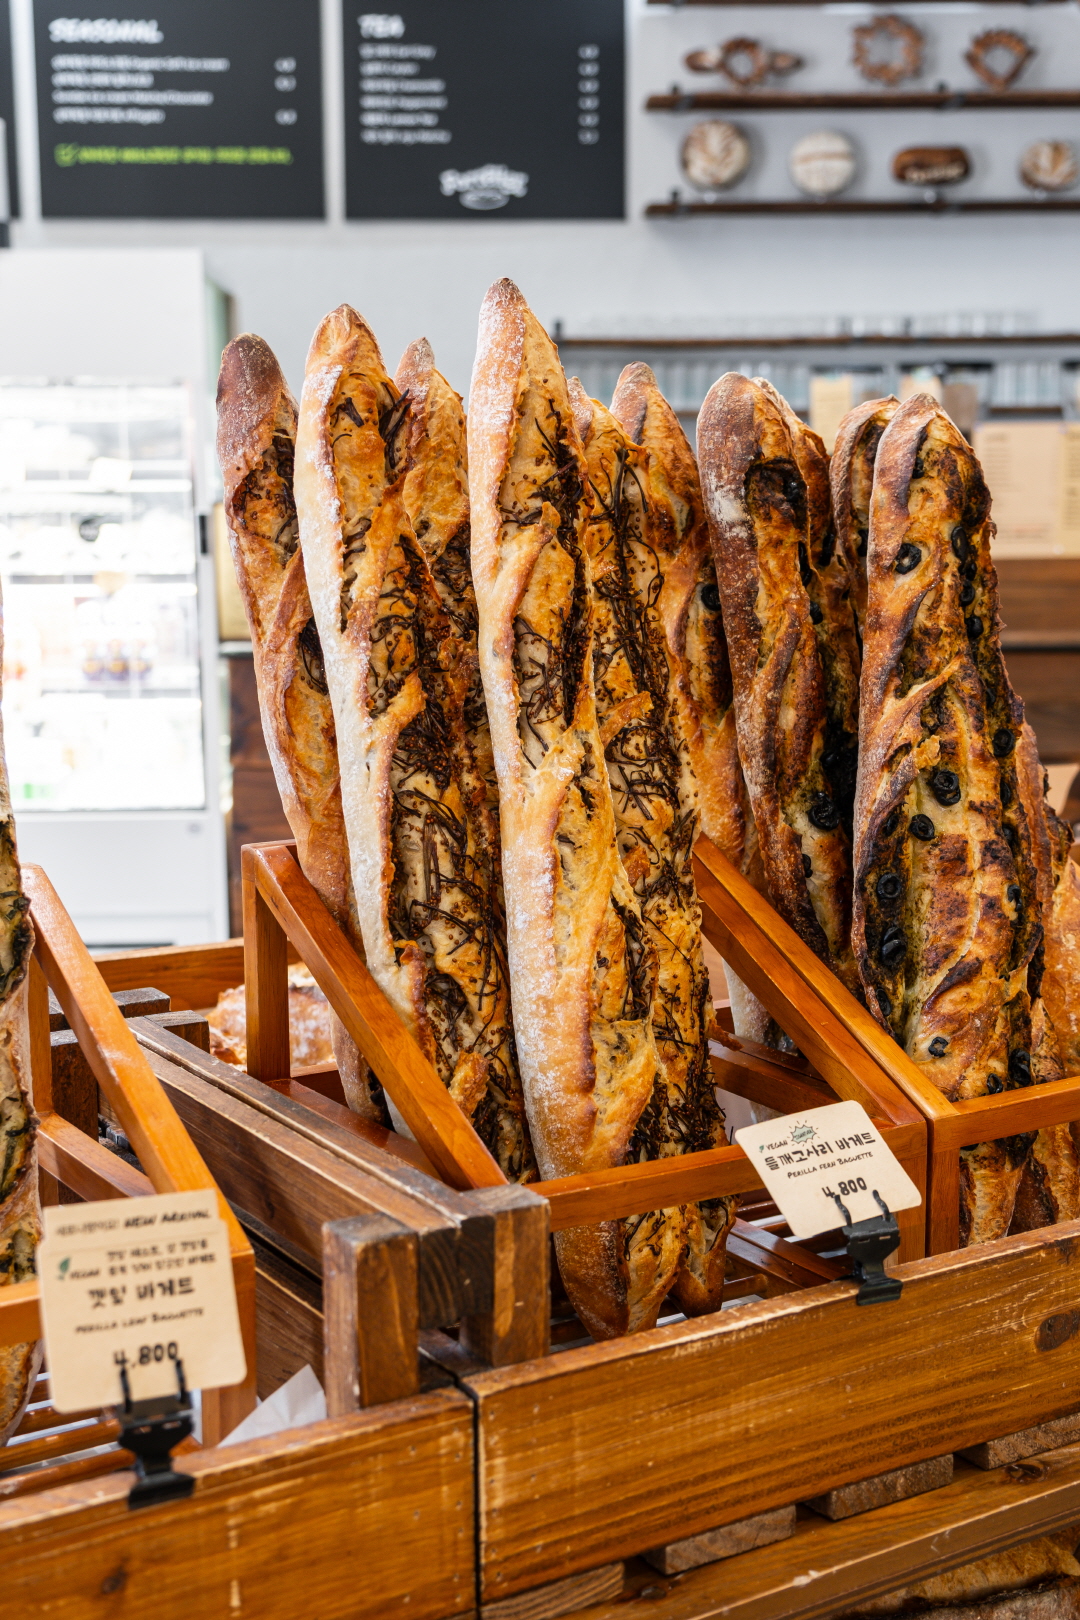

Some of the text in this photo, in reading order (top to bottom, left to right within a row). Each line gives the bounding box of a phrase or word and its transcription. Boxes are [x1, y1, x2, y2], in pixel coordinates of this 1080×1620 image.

[764, 1141, 834, 1171] 들깨고사리
[834, 1132, 876, 1150] 바게트
[766, 1140, 788, 1151] VEGAN
[787, 1151, 874, 1179] PERILLA FERN BAGUETTE
[821, 1176, 868, 1199] 4800
[124, 1215, 156, 1228] NEW
[161, 1210, 210, 1223] ARRIVAL
[88, 1276, 195, 1308] 깻잎 바게트
[114, 1341, 179, 1369] 4,800
